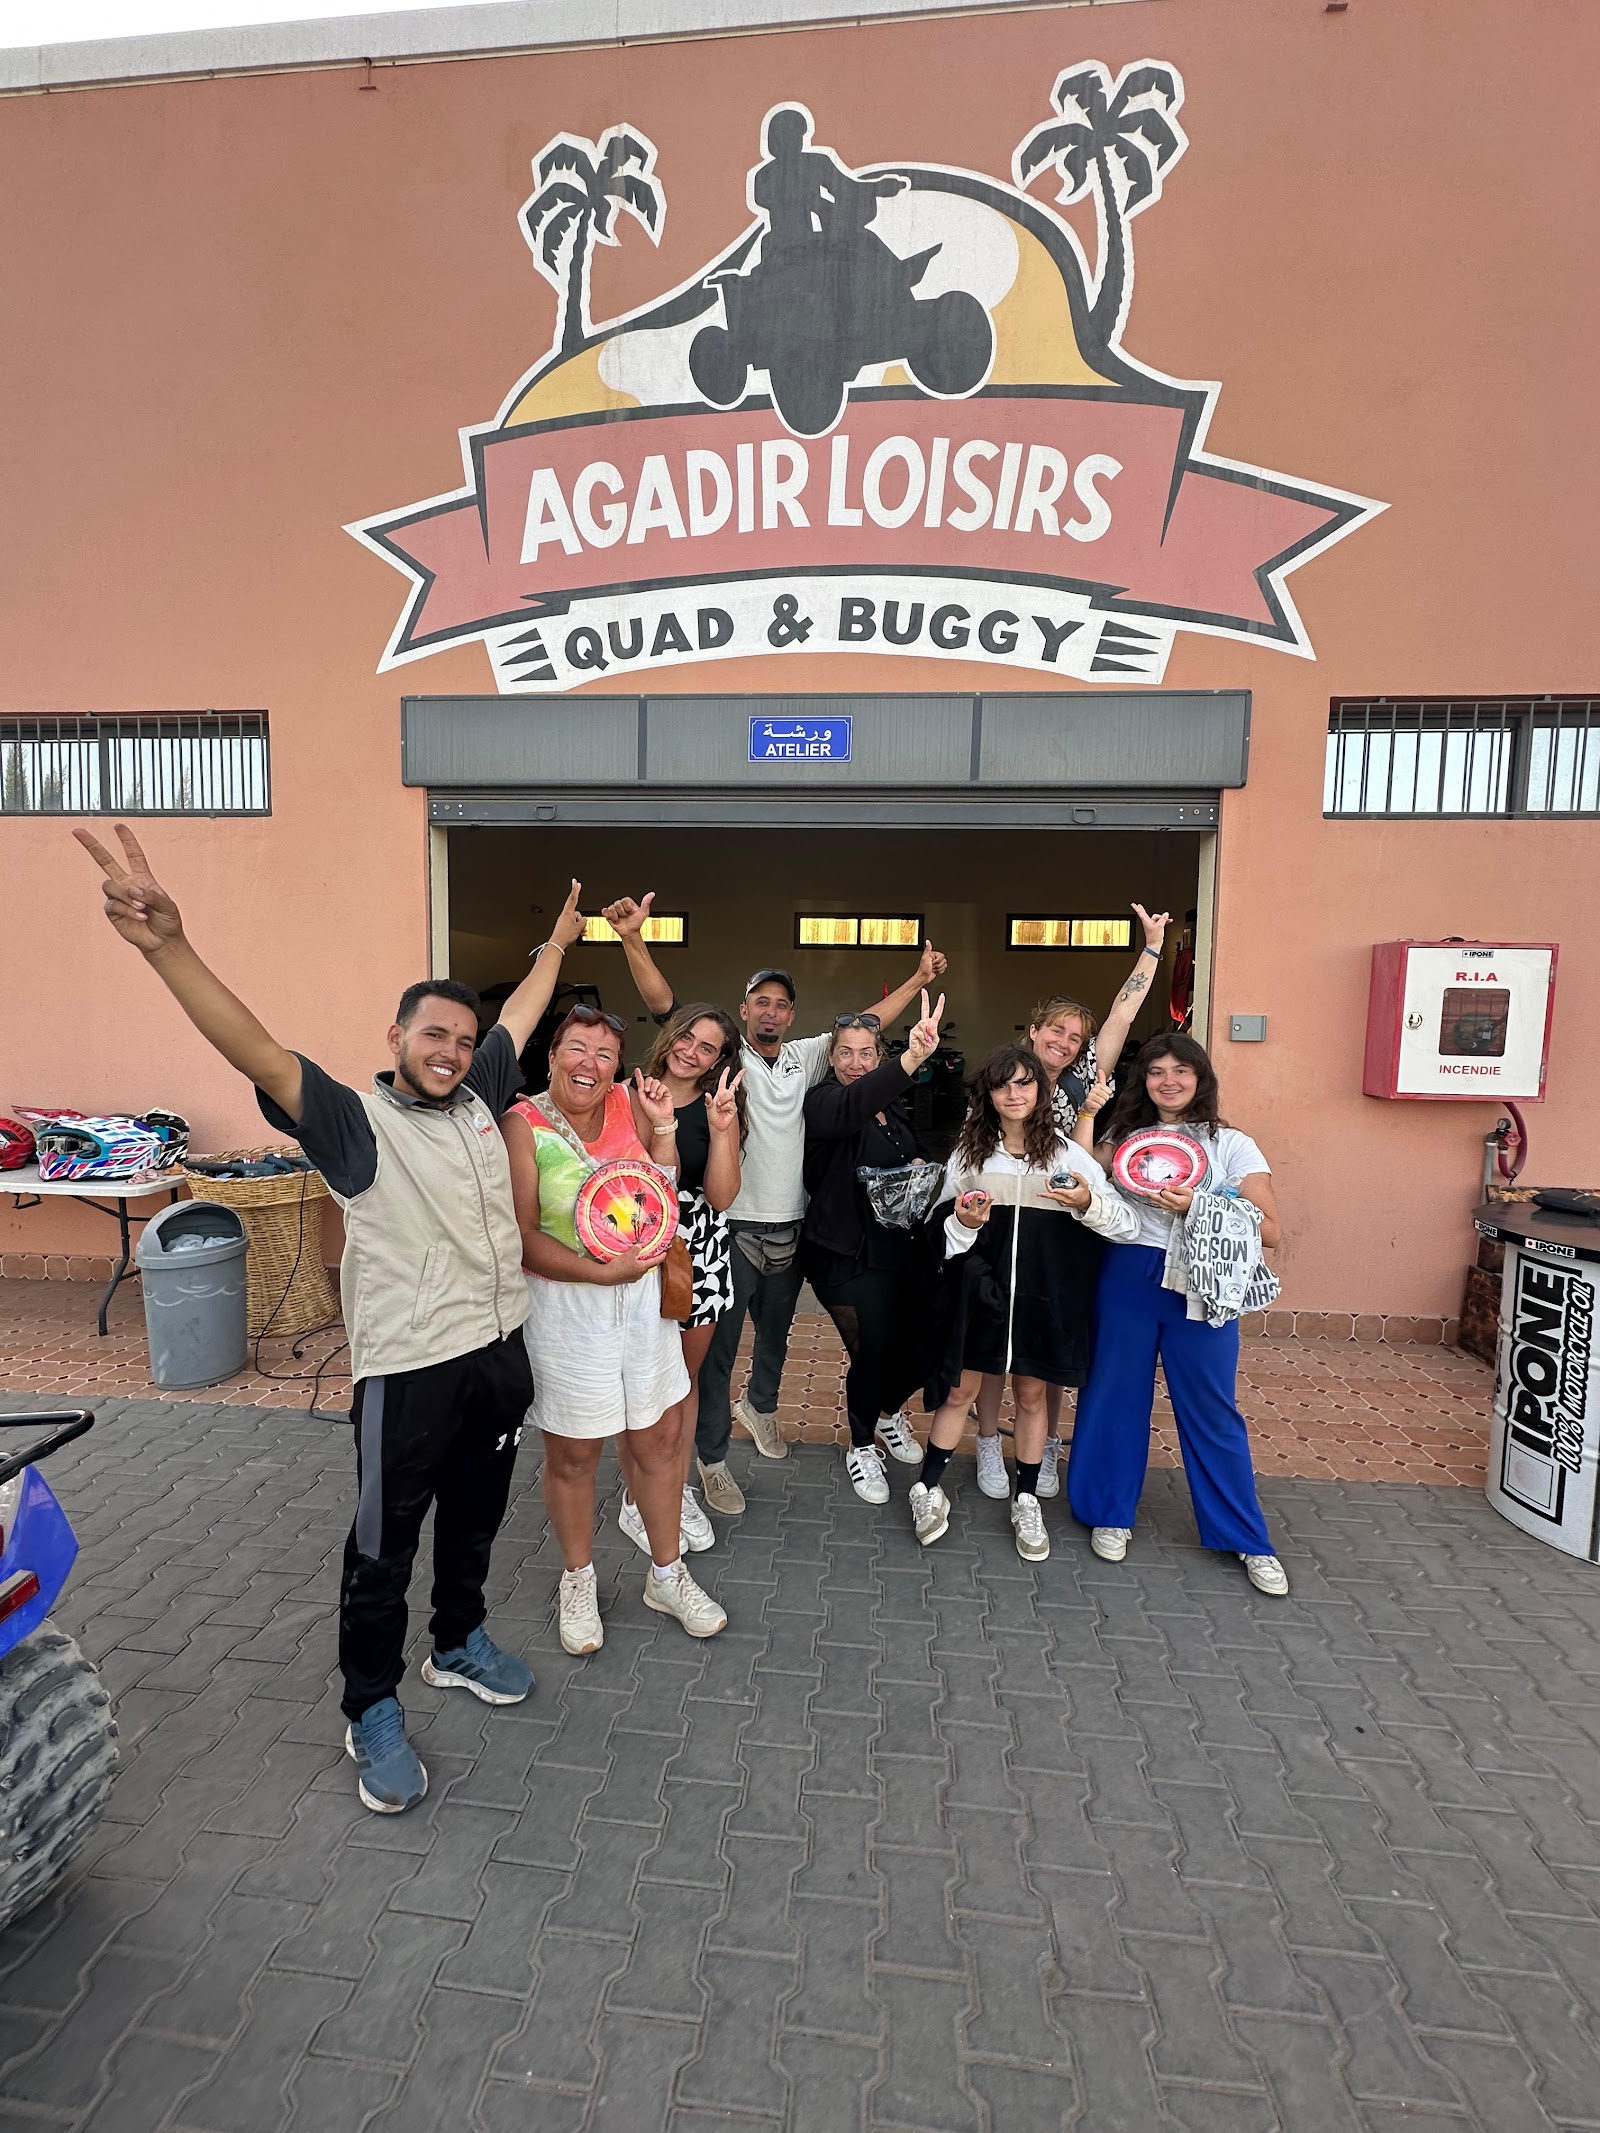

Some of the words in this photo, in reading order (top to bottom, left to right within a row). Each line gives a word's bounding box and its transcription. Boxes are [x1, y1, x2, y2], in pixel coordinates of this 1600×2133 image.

[520, 439, 811, 564] AGADIR
[828, 435, 1124, 542] LOISIRS
[565, 607, 734, 671] QUAD
[767, 593, 814, 648] &
[838, 597, 1085, 663] BUGGY
[765, 743, 832, 757] ATELIER
[1455, 972, 1498, 982] R.I.A
[1439, 1064, 1502, 1076] INCENDIE
[1534, 1241, 1576, 1258] IPONE
[1571, 1280, 1592, 1310] OIL
[1511, 1265, 1565, 1459] IPONE
[1562, 1307, 1589, 1417] MOTORCYCLE
[1556, 1412, 1582, 1471] 100%
